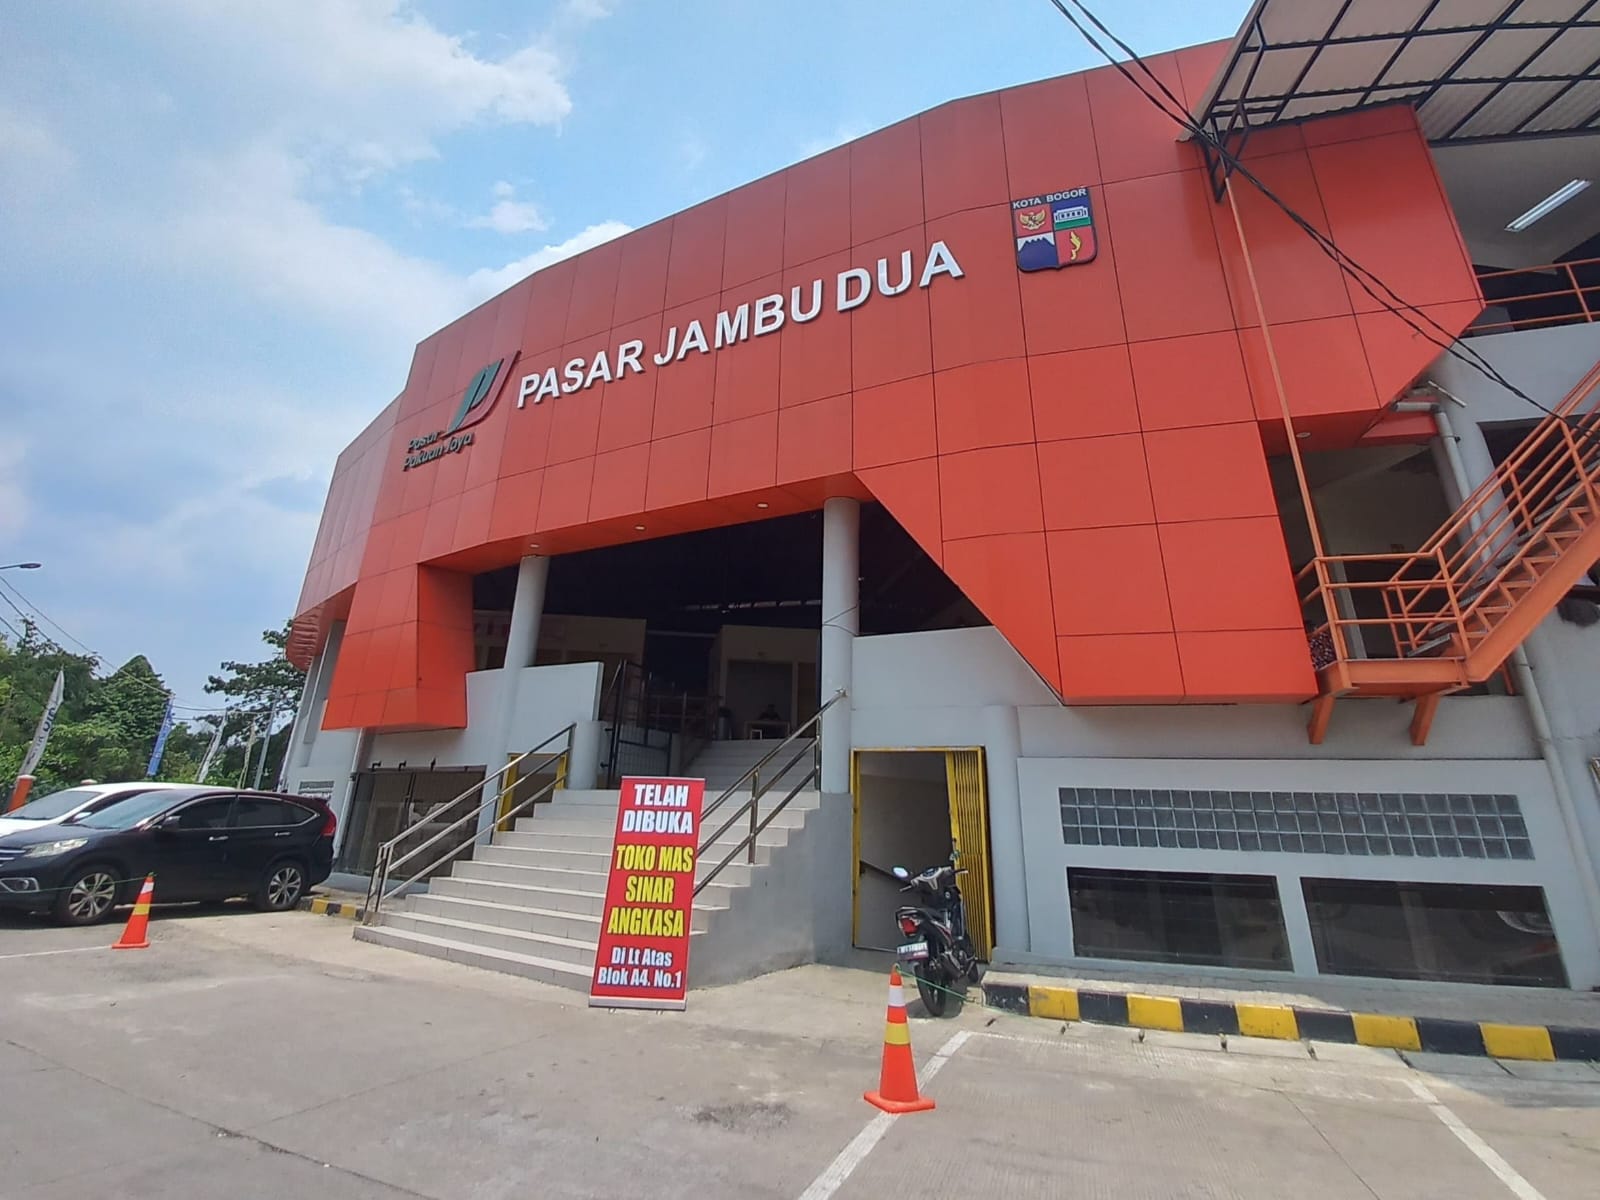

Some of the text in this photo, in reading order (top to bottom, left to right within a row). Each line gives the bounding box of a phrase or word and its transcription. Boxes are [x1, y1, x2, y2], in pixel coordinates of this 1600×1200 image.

[1013, 188, 1087, 209] KOTA BOGOR
[517, 240, 965, 409] PASAR JAMBU DUA
[408, 431, 440, 453] Pasar
[634, 783, 689, 807] TELAH
[622, 810, 694, 834] DIBUKA
[616, 844, 694, 872] TOKO MAS
[625, 875, 675, 904] SINAR
[607, 907, 684, 937] ANGKASA
[611, 946, 673, 967] Di Lt Atas
[597, 966, 629, 985] Blok
[653, 969, 682, 988] No.1
